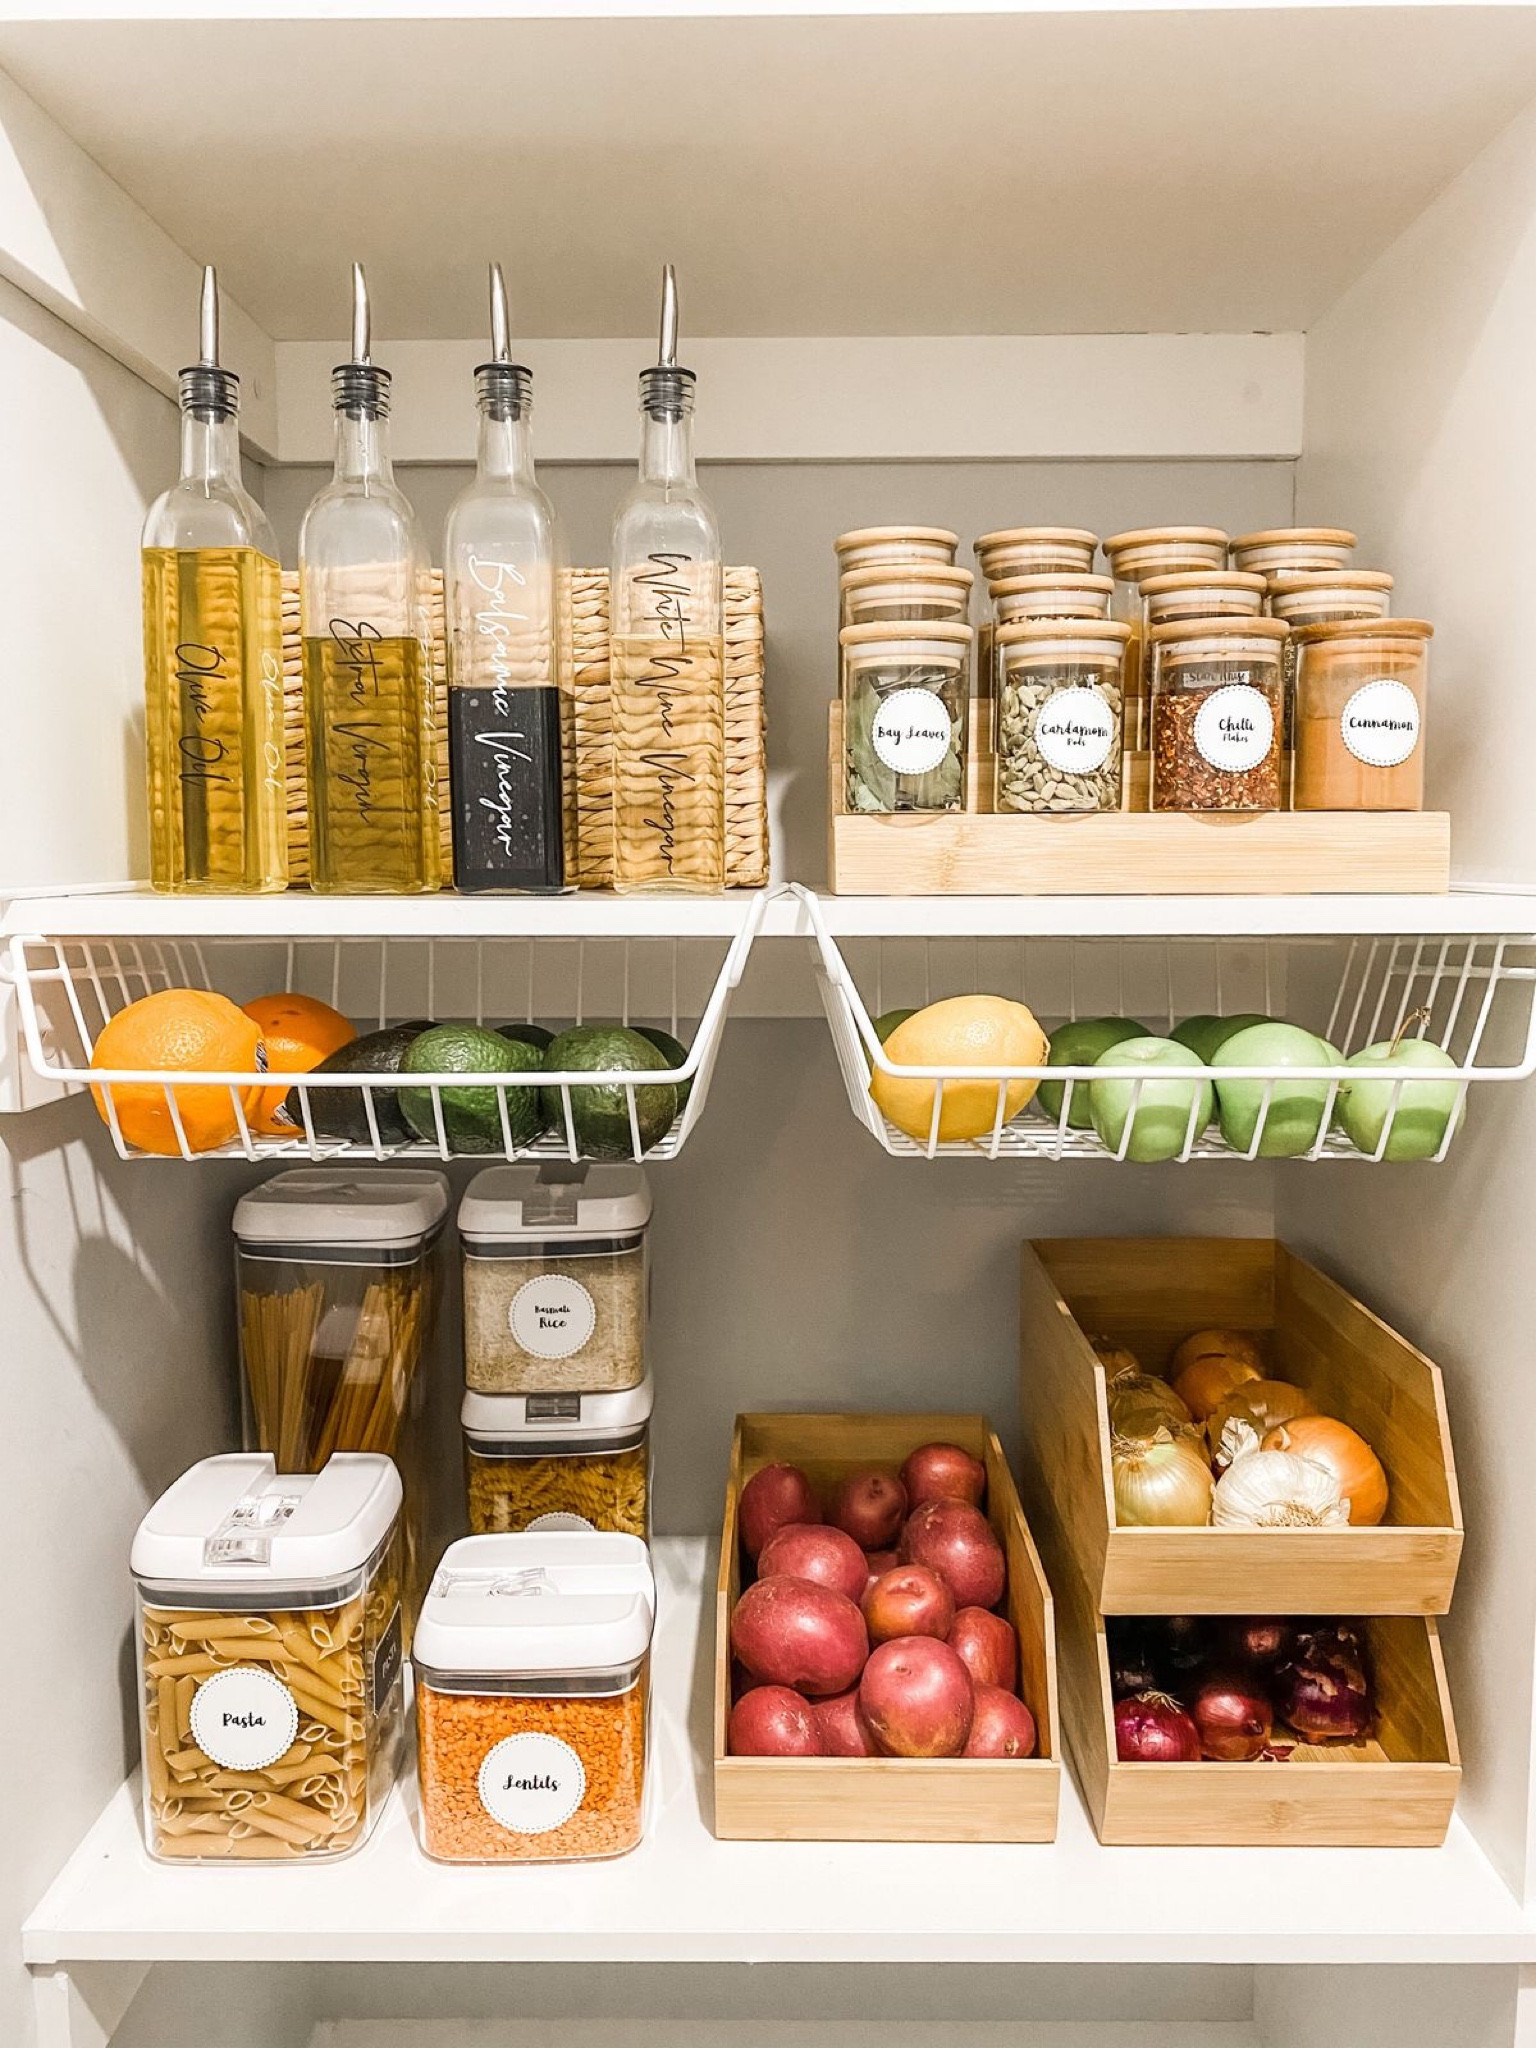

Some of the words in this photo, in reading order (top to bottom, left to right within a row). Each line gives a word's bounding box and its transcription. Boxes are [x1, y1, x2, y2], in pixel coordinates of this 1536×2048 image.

[632, 552, 692, 653] White
[468, 554, 529, 717] Balsamic
[175, 643, 227, 723] Olive
[328, 617, 385, 706] Extra
[634, 656, 693, 738] Wine
[877, 725, 901, 746] Bay
[905, 726, 946, 741] Leaves
[1041, 720, 1109, 738] Cardamom
[1218, 716, 1256, 732] Chilli
[1223, 732, 1249, 743] Flakes
[1349, 716, 1414, 732] Cinnamon
[178, 736, 231, 786] Oil
[332, 722, 391, 824] Virgin
[474, 731, 533, 857] Vinegar
[639, 753, 696, 876] Vinegar
[539, 1316, 568, 1329] Rice
[223, 1711, 267, 1729] Pasta
[502, 1774, 562, 1792] Lentils
